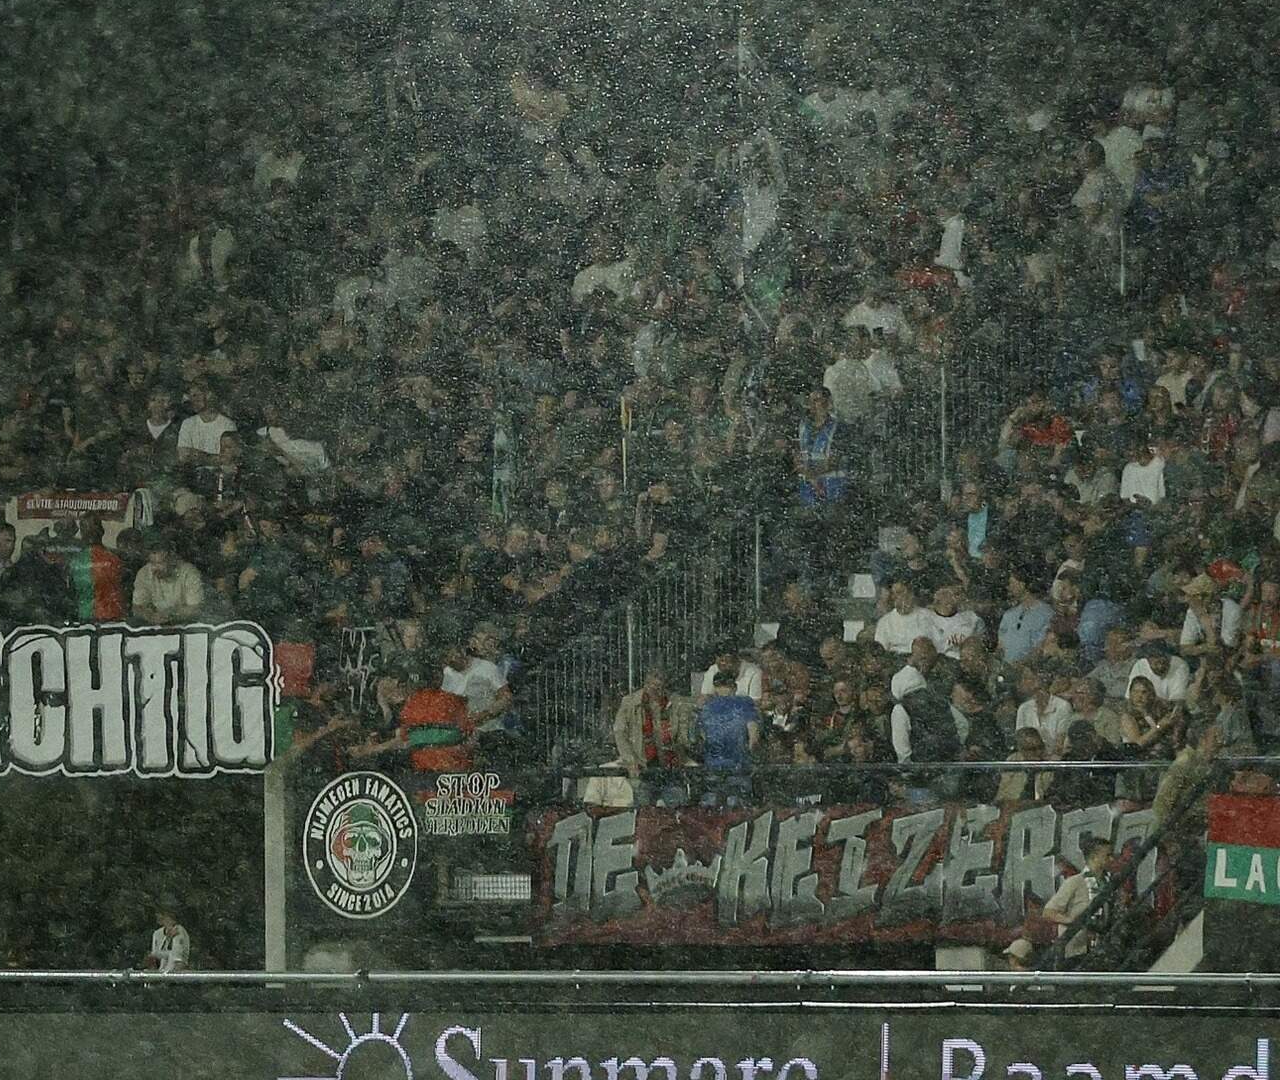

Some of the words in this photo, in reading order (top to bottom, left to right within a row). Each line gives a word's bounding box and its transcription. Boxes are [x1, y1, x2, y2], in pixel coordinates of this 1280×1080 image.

[364, 778, 413, 839] FANATICS
[1214, 848, 1280, 894] LA
[326, 882, 362, 911] SINCE
[362, 883, 395, 911] 2014
